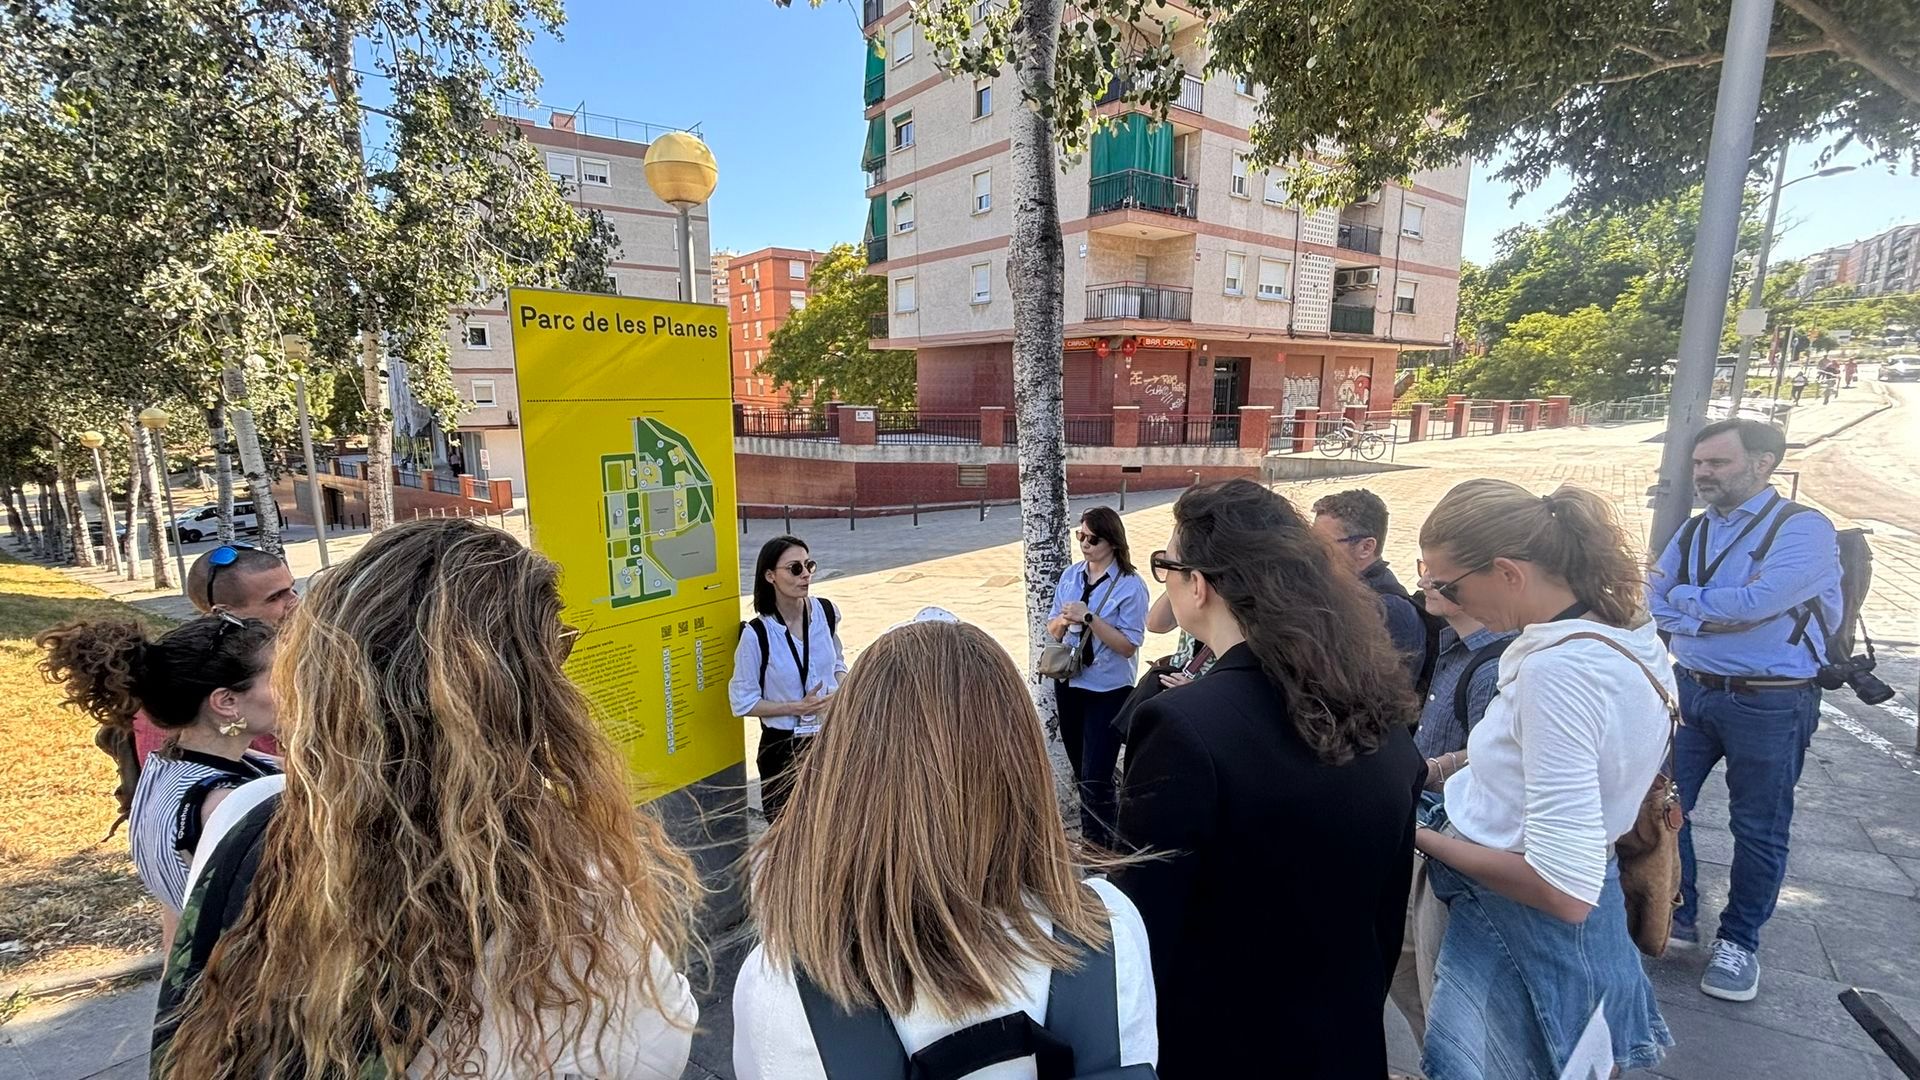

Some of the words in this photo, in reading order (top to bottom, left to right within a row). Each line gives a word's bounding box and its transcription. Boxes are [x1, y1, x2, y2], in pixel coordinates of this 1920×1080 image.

[520, 305, 575, 331] Parc
[582, 310, 609, 332] de
[615, 312, 647, 335] les
[653, 315, 718, 339] Planes
[1145, 338, 1160, 346] BAR
[1162, 338, 1184, 347] CAROL
[178, 803, 190, 840] Quechua
